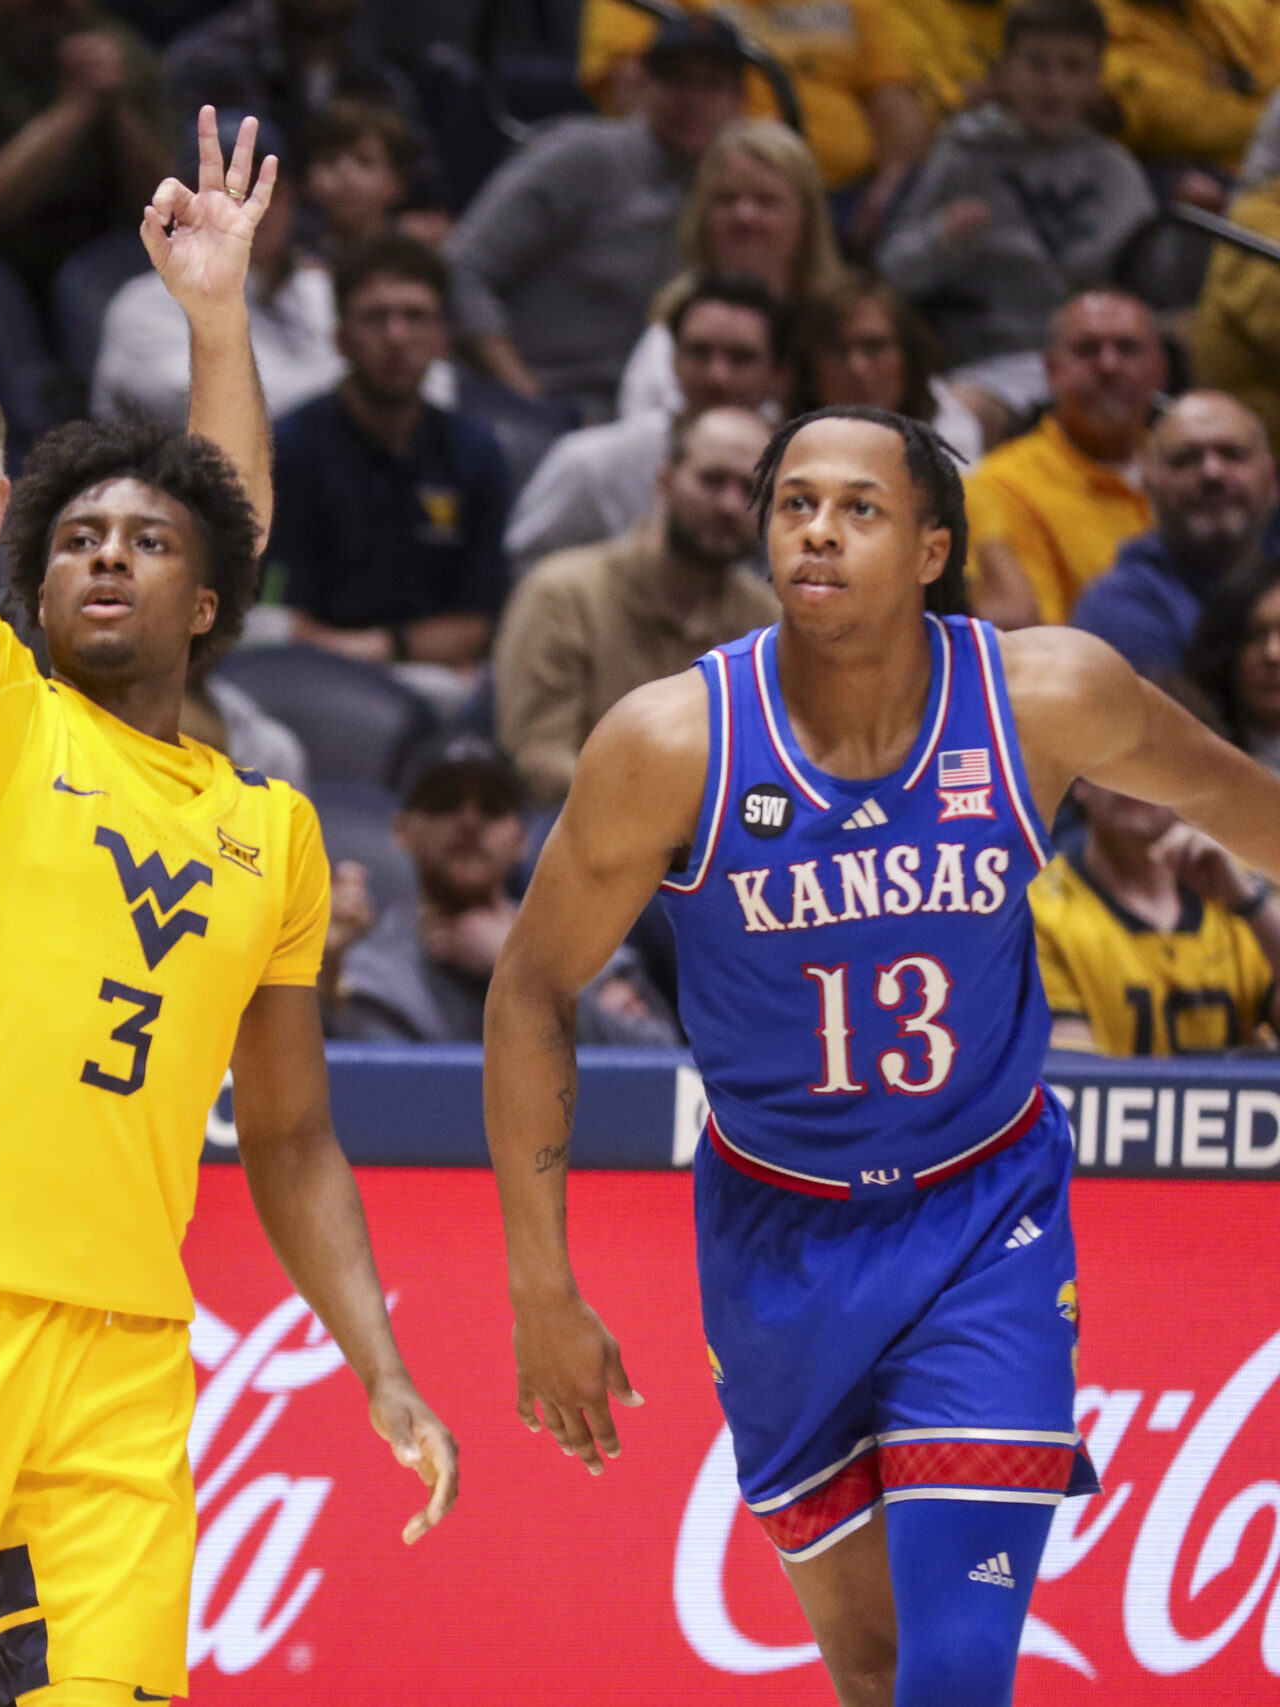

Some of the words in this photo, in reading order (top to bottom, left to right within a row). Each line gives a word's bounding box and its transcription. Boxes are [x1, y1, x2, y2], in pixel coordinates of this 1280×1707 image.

[744, 794, 789, 827] SW
[726, 842, 1011, 933] KANSAS
[78, 976, 164, 1097] 3
[800, 951, 961, 1097] 13
[860, 1167, 901, 1186] KU
[967, 1569, 1016, 1590] adidas
